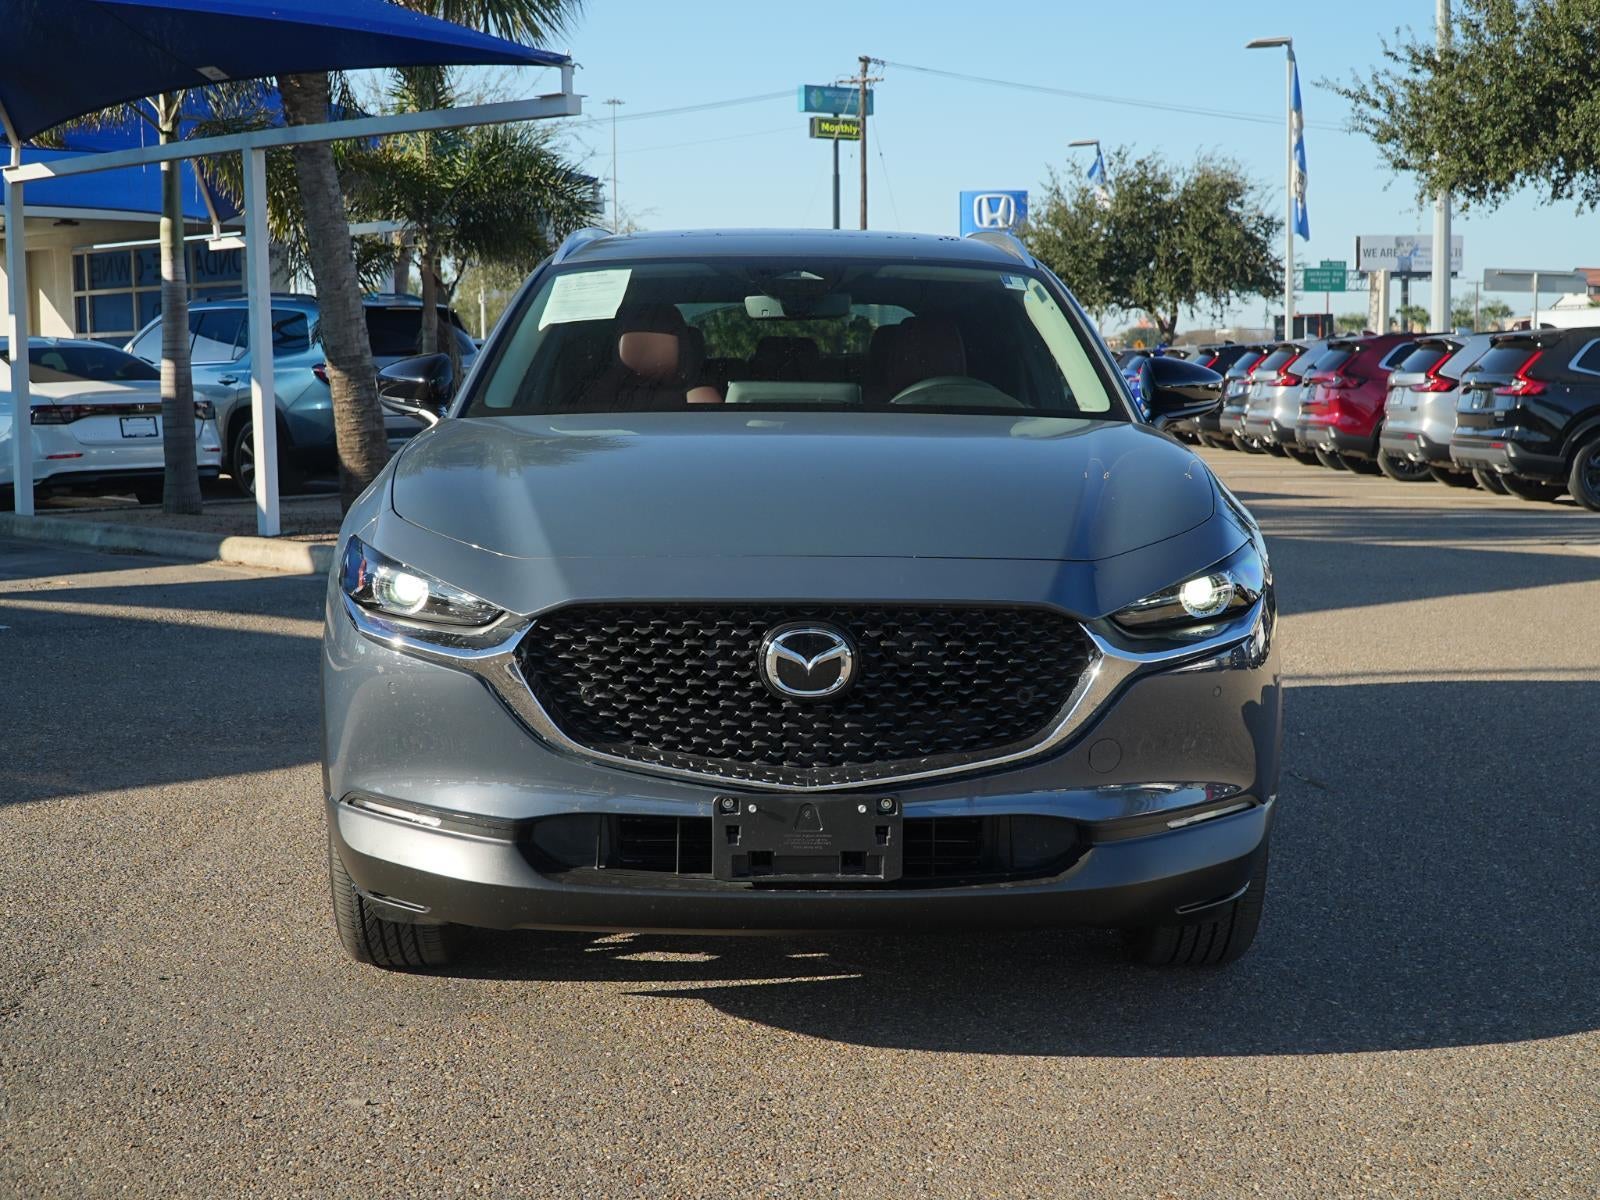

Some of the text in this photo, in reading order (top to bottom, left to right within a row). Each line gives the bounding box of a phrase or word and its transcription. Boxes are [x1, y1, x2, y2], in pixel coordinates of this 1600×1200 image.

[821, 122, 859, 135] Monthly
[1363, 248, 1398, 258] WE ARE
